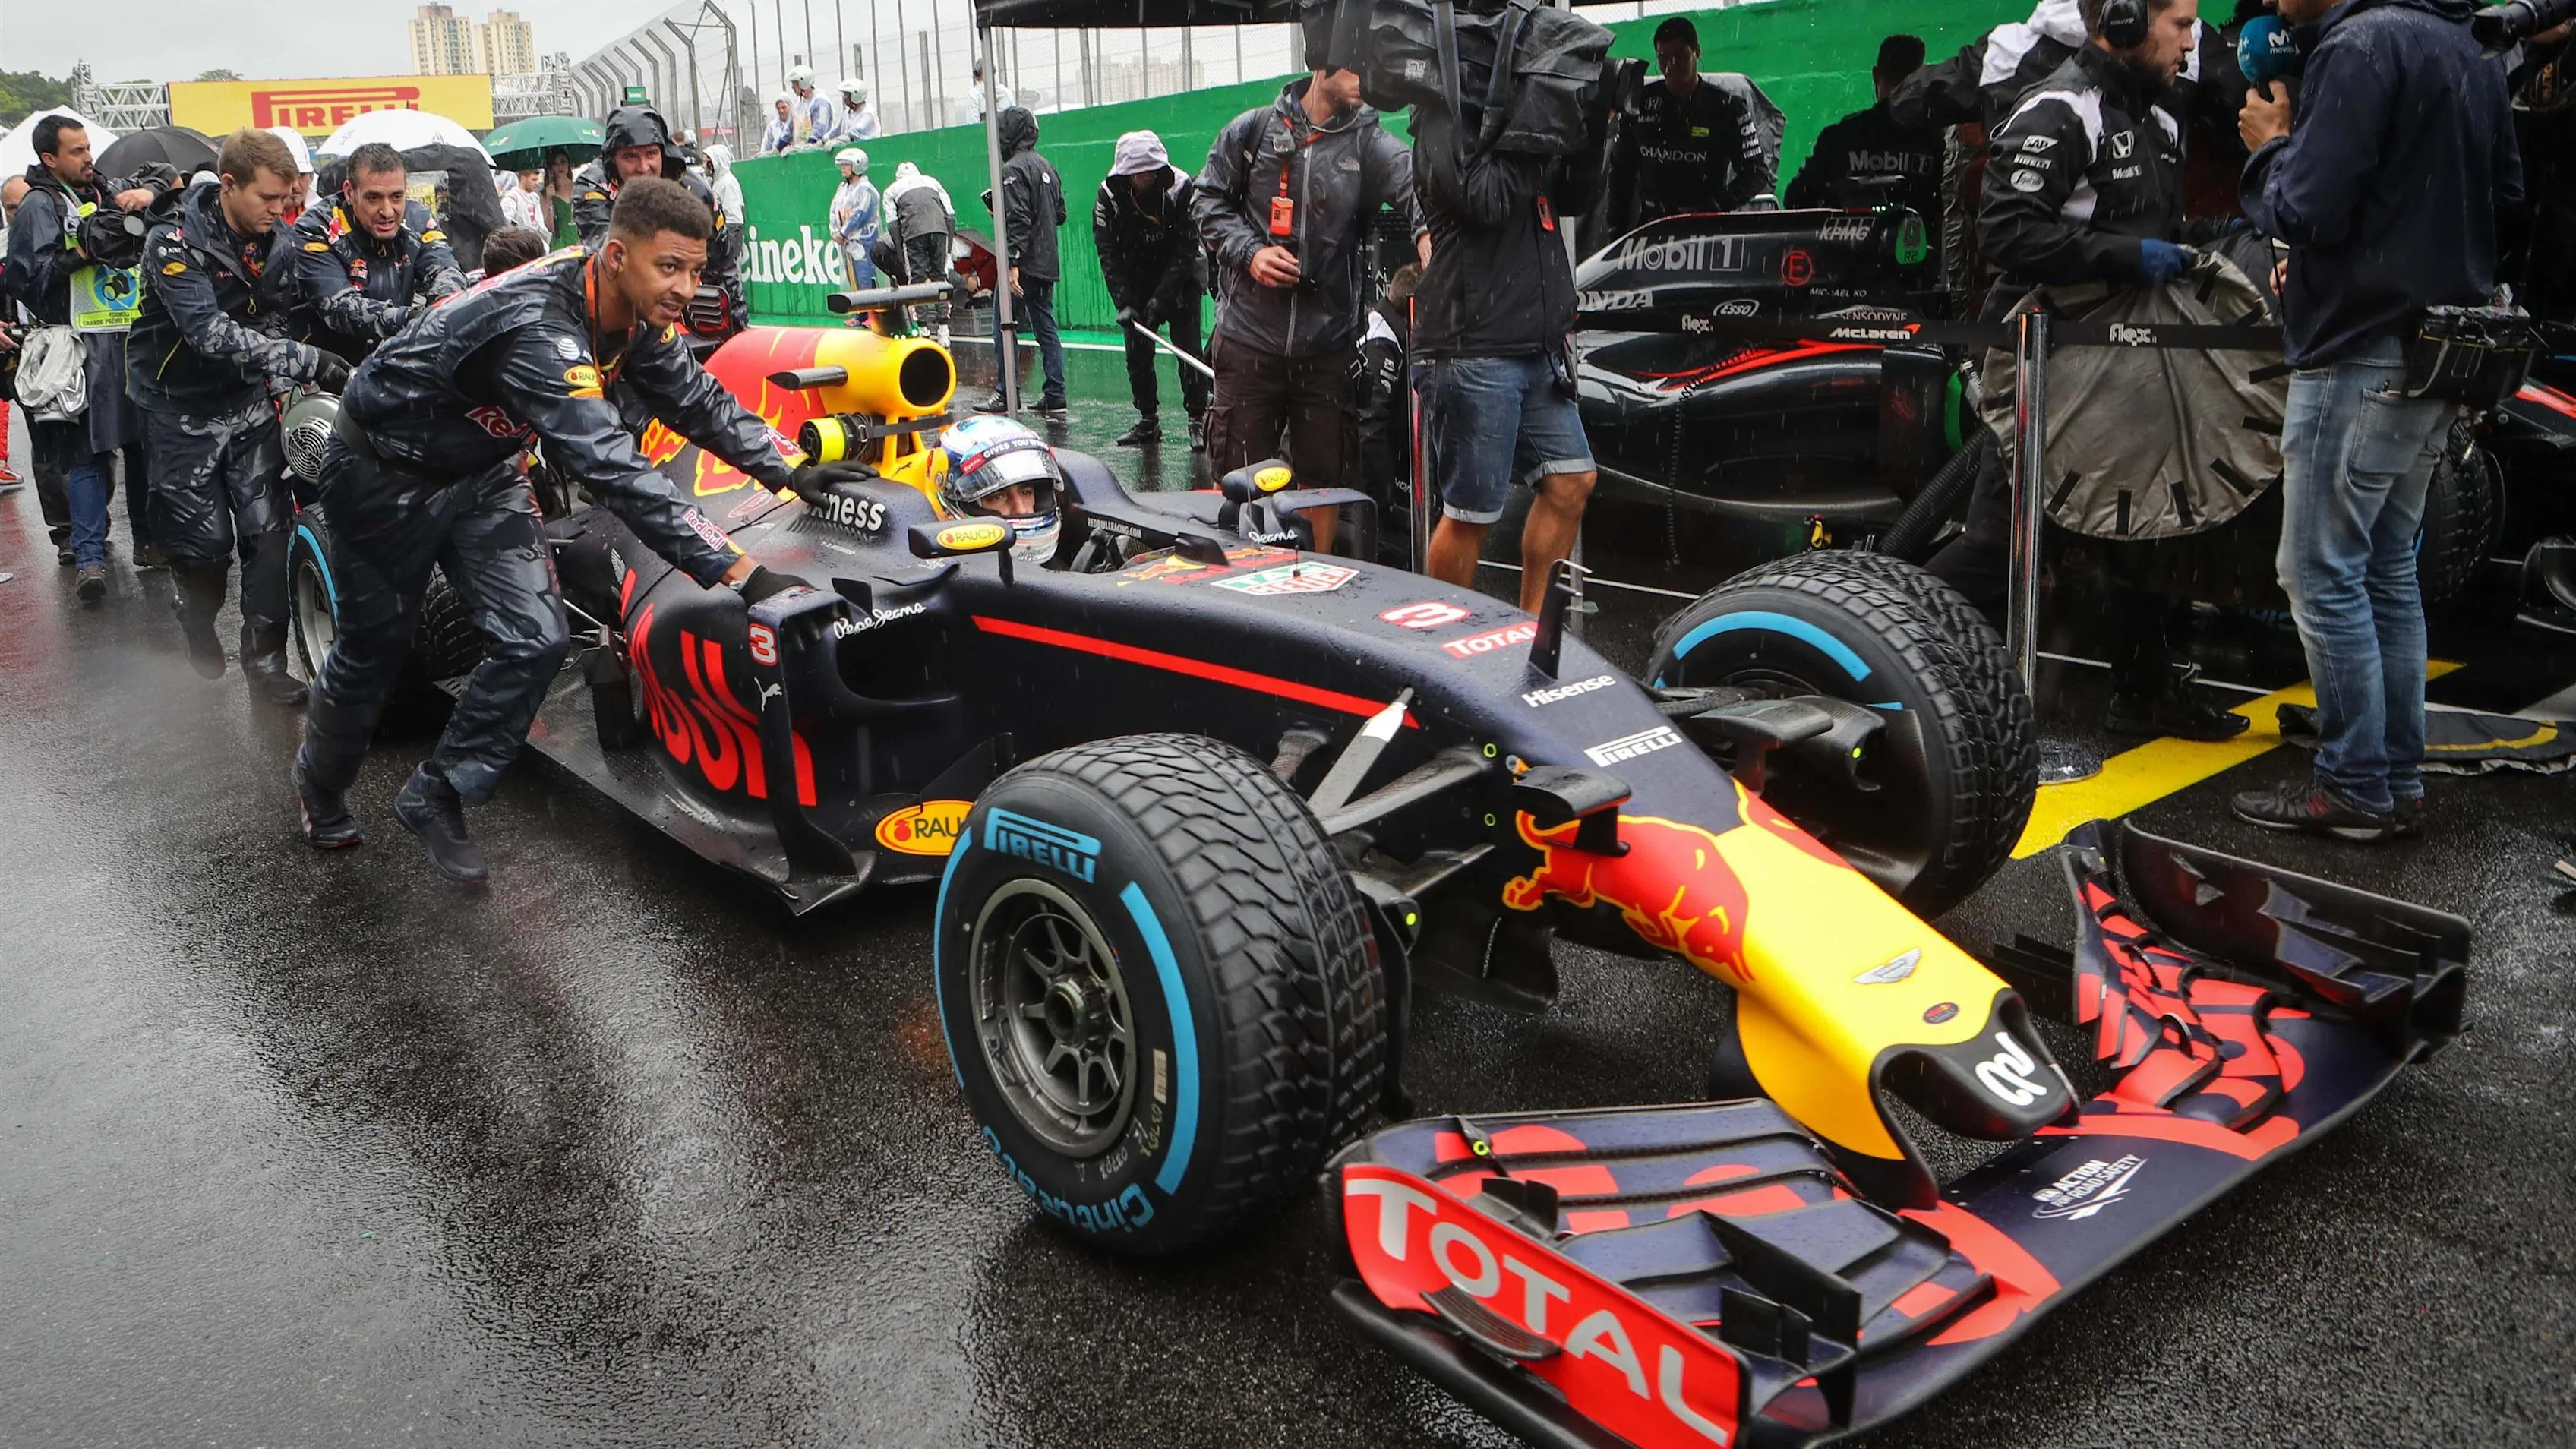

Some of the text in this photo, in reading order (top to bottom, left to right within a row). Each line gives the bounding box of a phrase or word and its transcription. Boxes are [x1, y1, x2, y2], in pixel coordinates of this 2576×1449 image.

[251, 86, 421, 130] PIRE
[1820, 226, 1870, 241] KPMG
[735, 225, 841, 286] eineke
[1618, 235, 1706, 270] Mobil
[1577, 291, 1654, 312] ONDA
[1829, 327, 1911, 341] McLaren
[983, 442, 1010, 459] GIVES
[1012, 438, 1029, 448] YOU
[955, 529, 996, 544] RAUCH
[872, 602, 927, 629] Jeans
[1381, 601, 1469, 629] 3
[749, 625, 778, 665] 3
[1521, 674, 1616, 708] Hisense
[1583, 725, 1684, 768] PIRELLI
[914, 816, 961, 838] RAU
[983, 807, 1102, 884] PIRELLI
[2051, 1159, 2110, 1192] ACTION
[2066, 1178, 2106, 1199] ROAD
[2095, 1154, 2142, 1182] SAFETY
[1344, 1177, 1731, 1447] TOTAL
